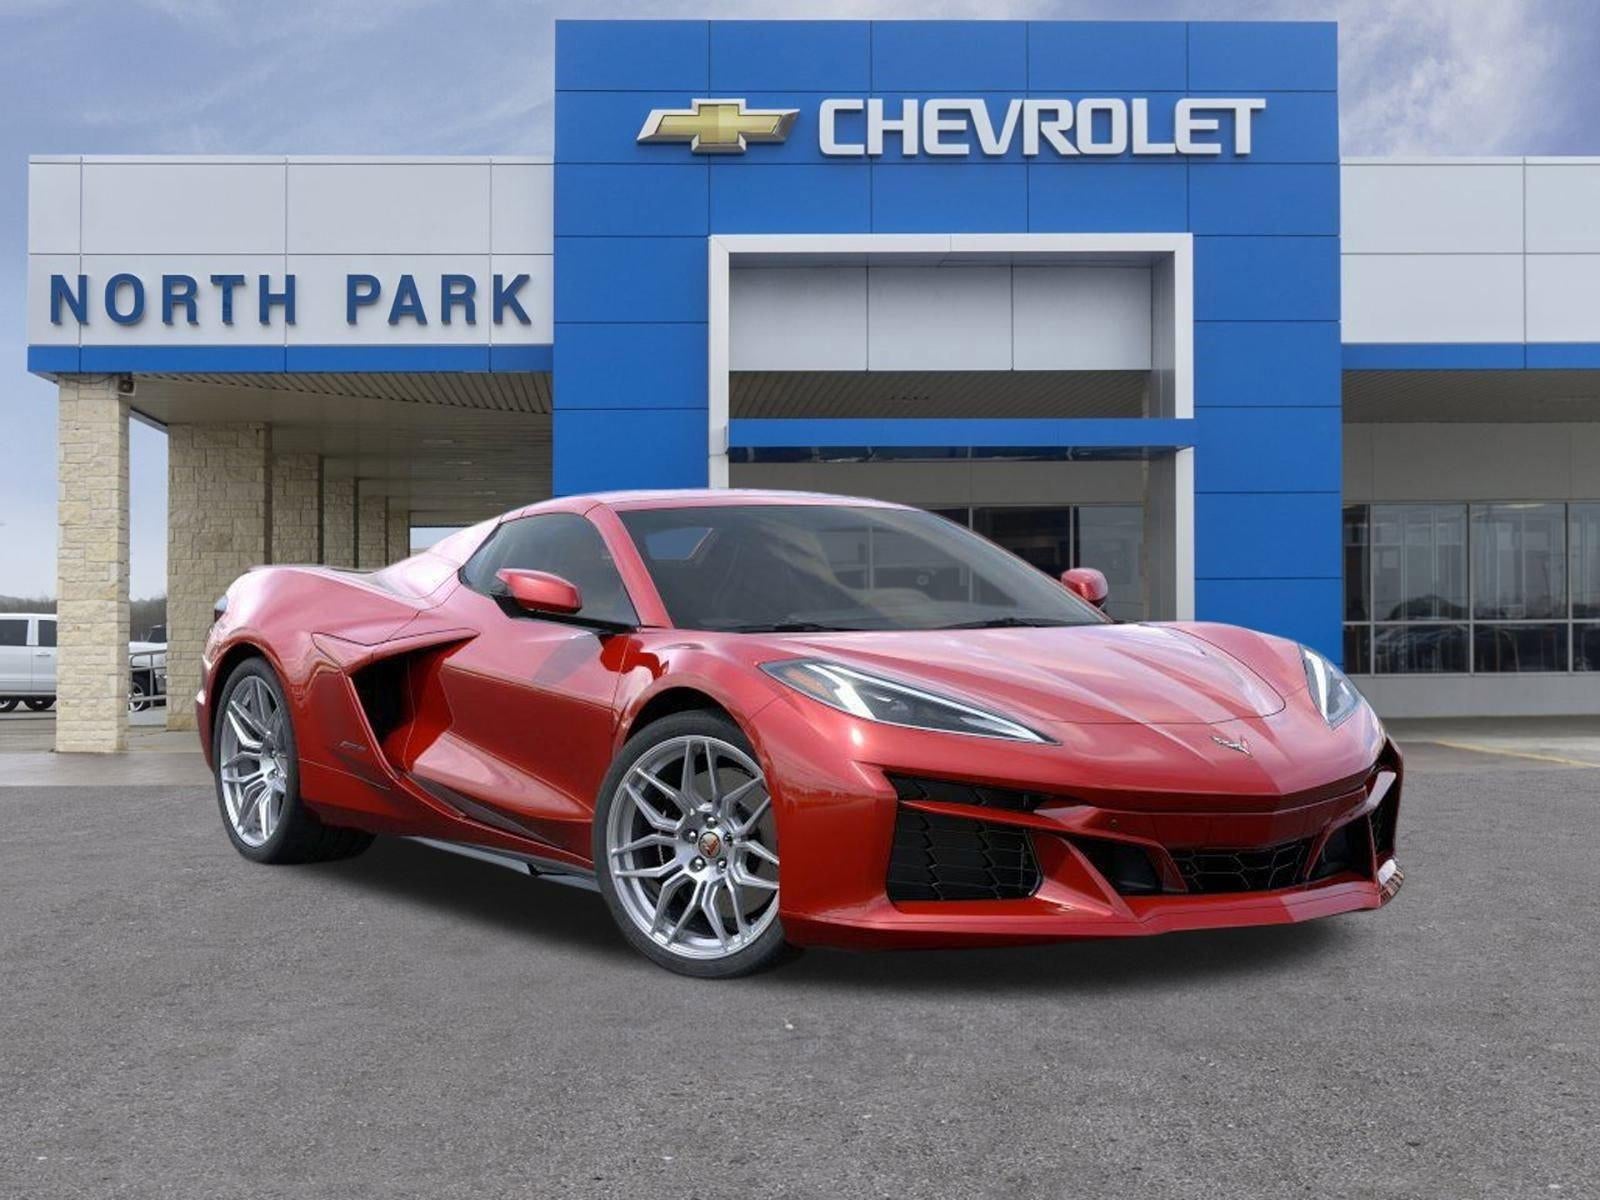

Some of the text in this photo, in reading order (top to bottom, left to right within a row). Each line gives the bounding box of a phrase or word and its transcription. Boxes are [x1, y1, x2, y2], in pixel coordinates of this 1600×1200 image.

[819, 97, 1267, 158] CHEVROLET
[50, 274, 533, 326] NORTH PARK
